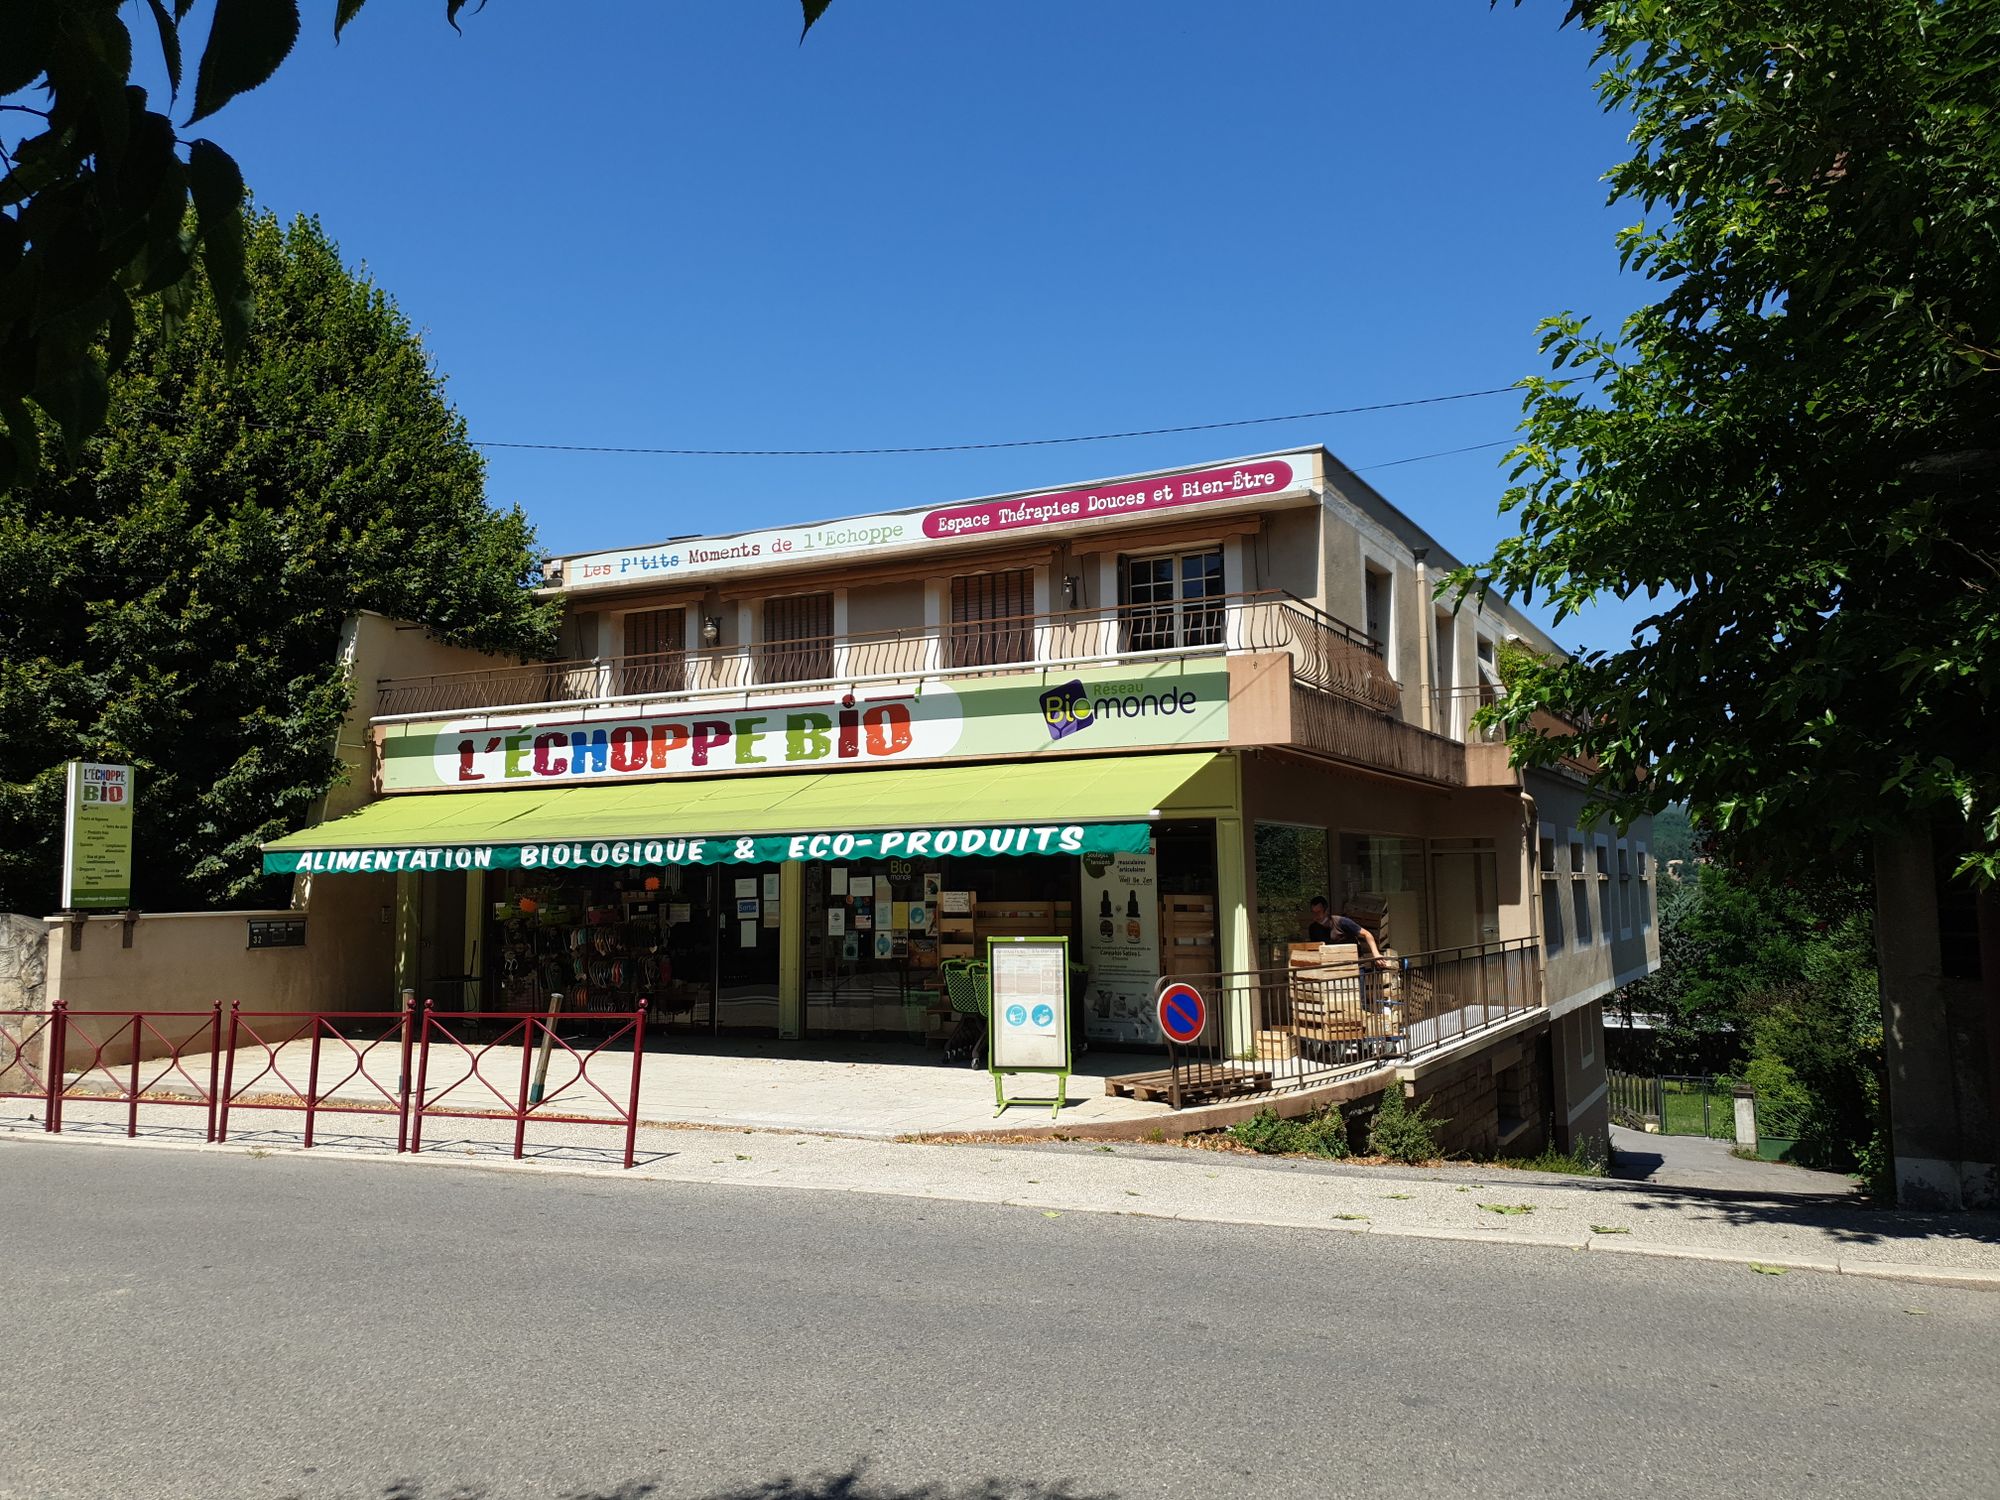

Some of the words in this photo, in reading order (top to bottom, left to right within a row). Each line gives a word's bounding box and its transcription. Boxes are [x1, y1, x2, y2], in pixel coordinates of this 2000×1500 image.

[937, 514, 991, 535] Espace
[998, 500, 1081, 528] Thérapies
[1087, 491, 1146, 512] Douces
[1153, 484, 1174, 501] et
[1181, 470, 1276, 498] Bien-Être
[582, 562, 612, 579] Les
[620, 553, 680, 573] P'tits
[688, 541, 762, 565] Moments
[771, 537, 793, 554] de
[803, 523, 904, 549] l'Echoppe
[1093, 681, 1144, 697] Réseau
[457, 715, 769, 782] L'ÉCHOPPE
[295, 846, 492, 872] ALIMENTATION
[520, 839, 706, 868] BIOLOGIQUE
[734, 836, 756, 860] &
[787, 825, 1085, 859] ECO-PRODUITS
[890, 860, 912, 875] Bio
[253, 935, 262, 944] 32
